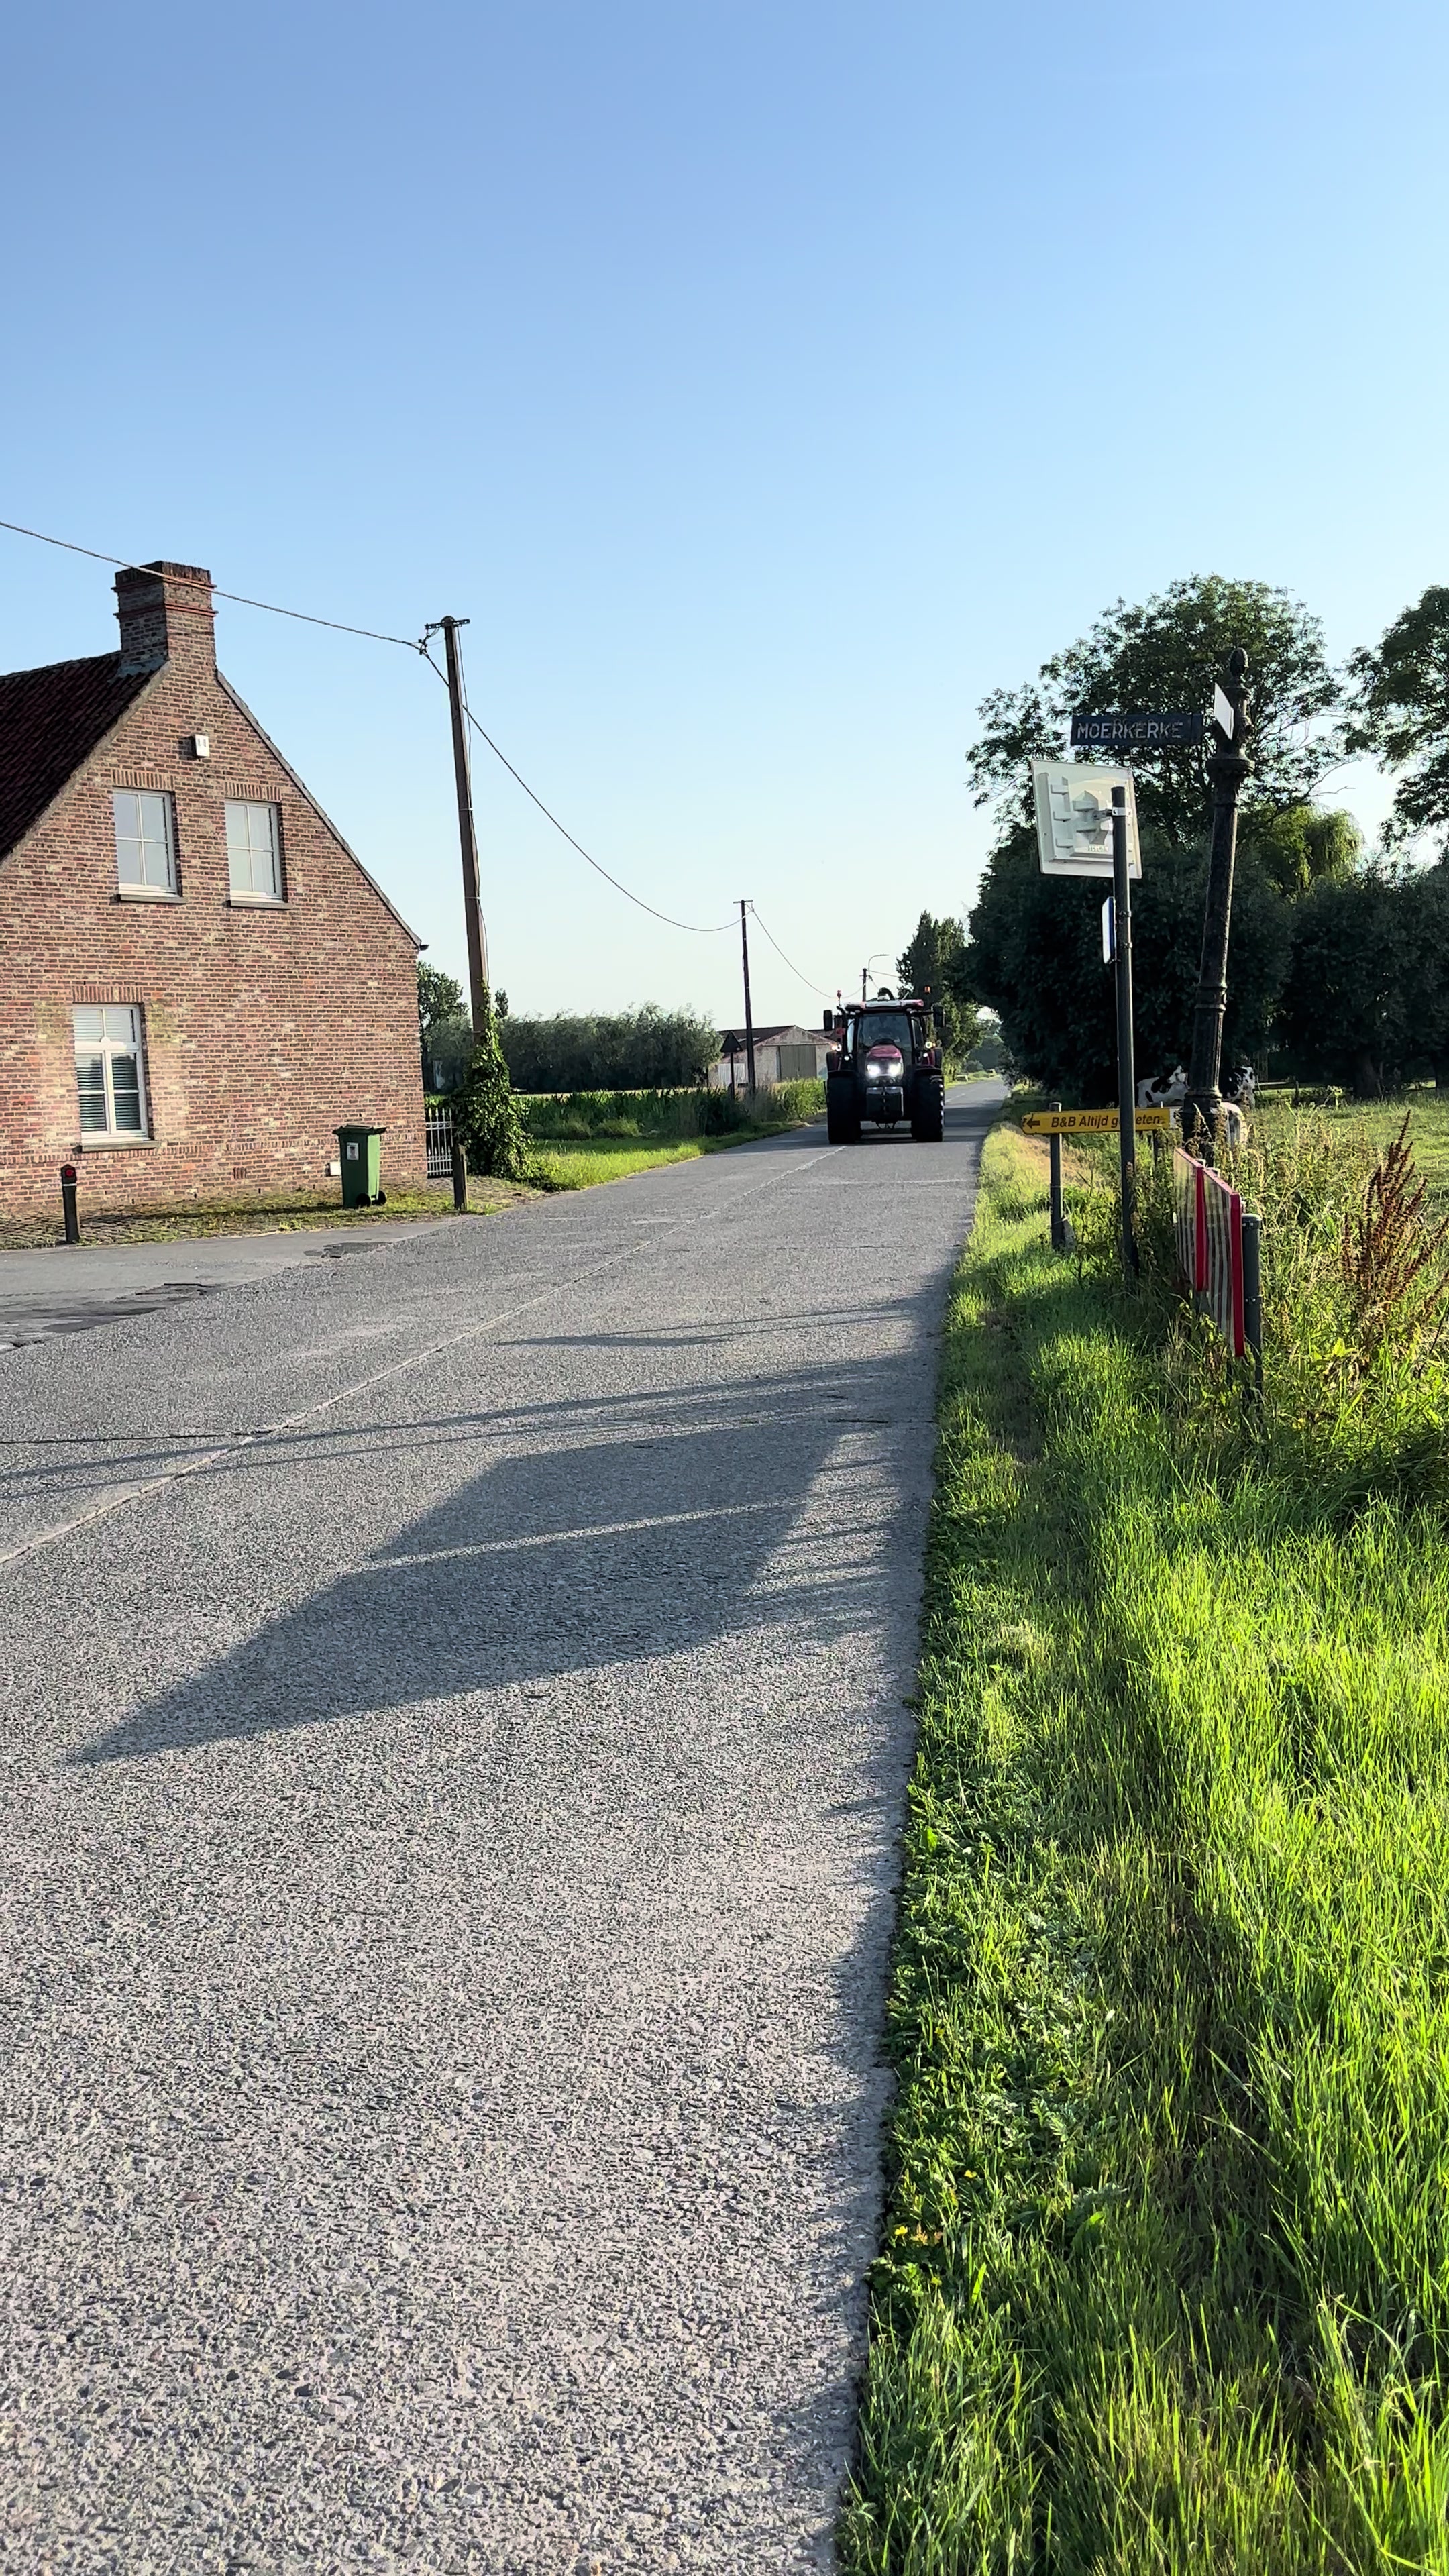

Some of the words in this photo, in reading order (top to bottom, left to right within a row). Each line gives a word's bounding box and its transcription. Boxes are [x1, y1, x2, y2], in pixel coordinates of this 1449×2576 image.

[1077, 721, 1183, 739] MOERKERKE
[1051, 1116, 1076, 1128] B&B
[1079, 1114, 1108, 1129] Altijd
[1111, 1114, 1160, 1128] geten
